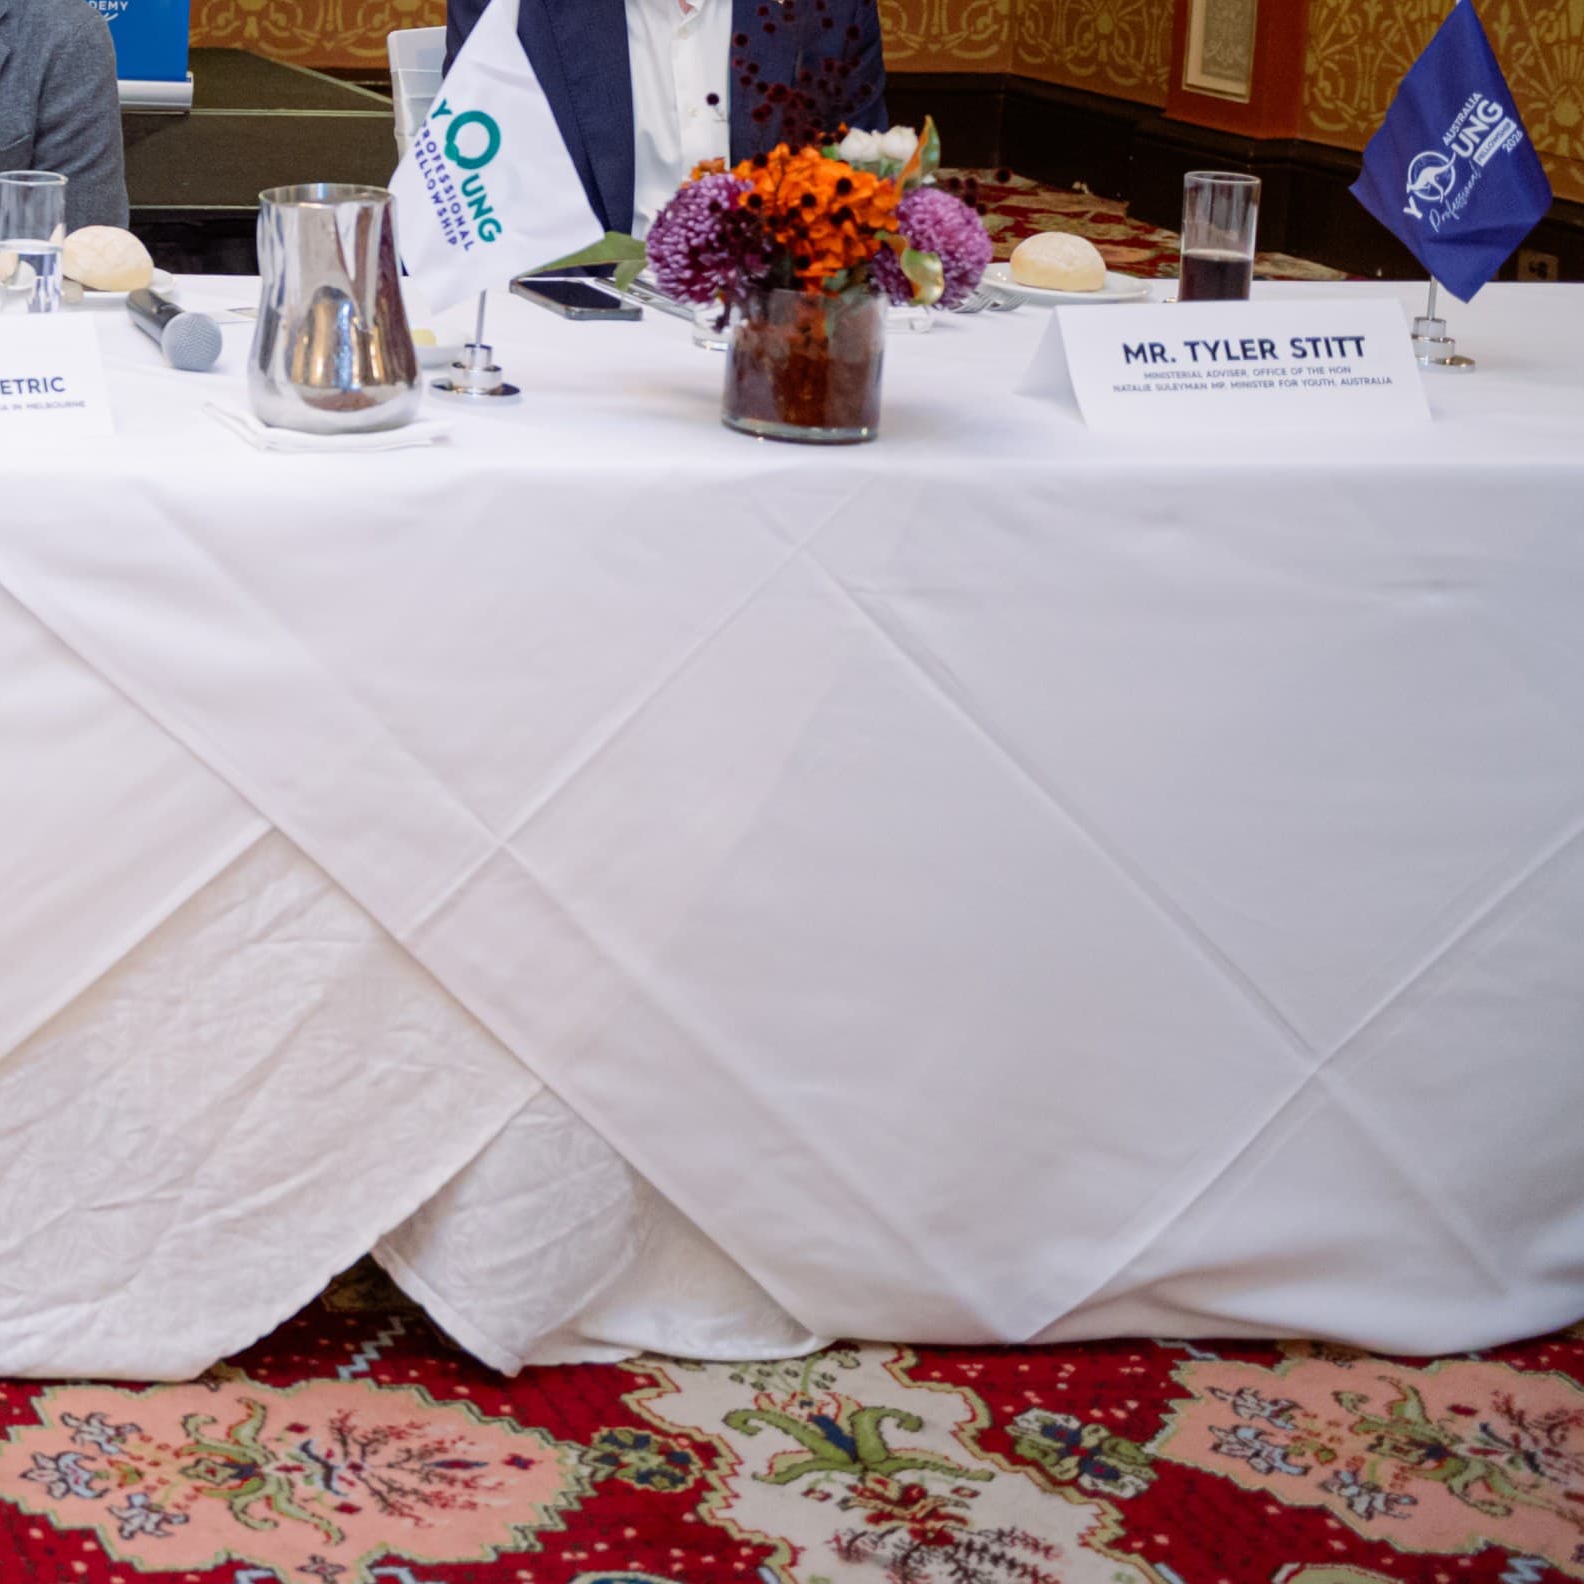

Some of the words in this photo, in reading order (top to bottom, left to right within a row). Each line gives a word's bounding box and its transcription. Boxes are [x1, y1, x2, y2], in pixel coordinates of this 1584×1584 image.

[1442, 92, 1483, 146] AUSTRALIA
[431, 99, 502, 243] YOUNG
[1123, 341, 1177, 364] MR.
[1184, 337, 1278, 362] TYLER
[1291, 335, 1365, 359] STITT
[1253, 368, 1288, 377] OFFICE
[1291, 367, 1304, 376] OF
[1307, 366, 1326, 375] THE
